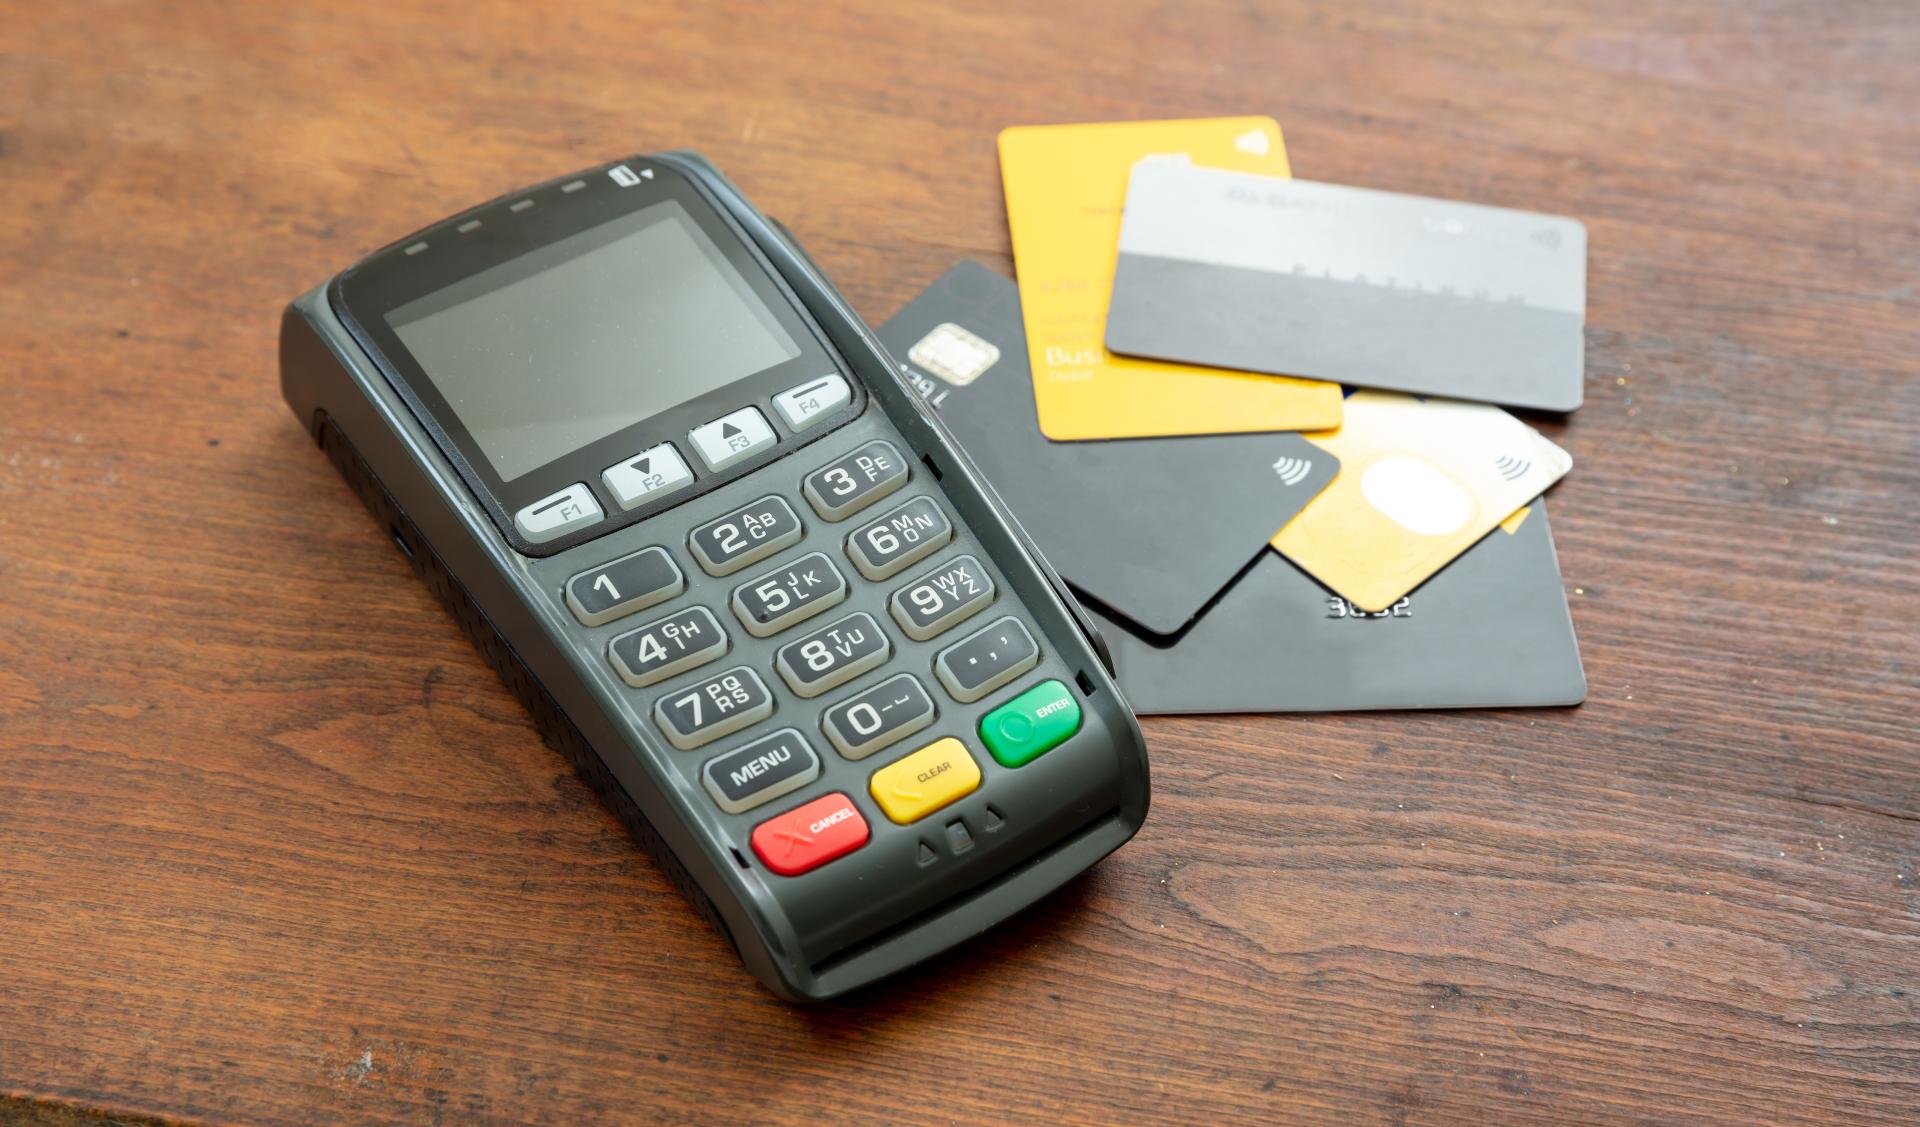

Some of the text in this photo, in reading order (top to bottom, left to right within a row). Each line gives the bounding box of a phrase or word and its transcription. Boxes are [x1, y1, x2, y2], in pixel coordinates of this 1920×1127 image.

[799, 398, 820, 415] F4
[727, 435, 751, 452] F3
[642, 474, 666, 492] F2
[824, 467, 857, 496] 3
[560, 503, 582, 522] F1
[712, 523, 748, 554] 2
[866, 525, 900, 555] 6
[593, 573, 621, 600] 1
[755, 580, 791, 612] 5
[910, 585, 944, 615] 9
[638, 633, 667, 664] 4
[800, 640, 835, 671] 8
[674, 692, 702, 727] 7
[847, 702, 882, 735] 0
[1036, 699, 1070, 719] ENTER
[730, 746, 792, 787] MENU
[917, 761, 952, 783] CLEAR
[809, 808, 855, 834] CANCEL
